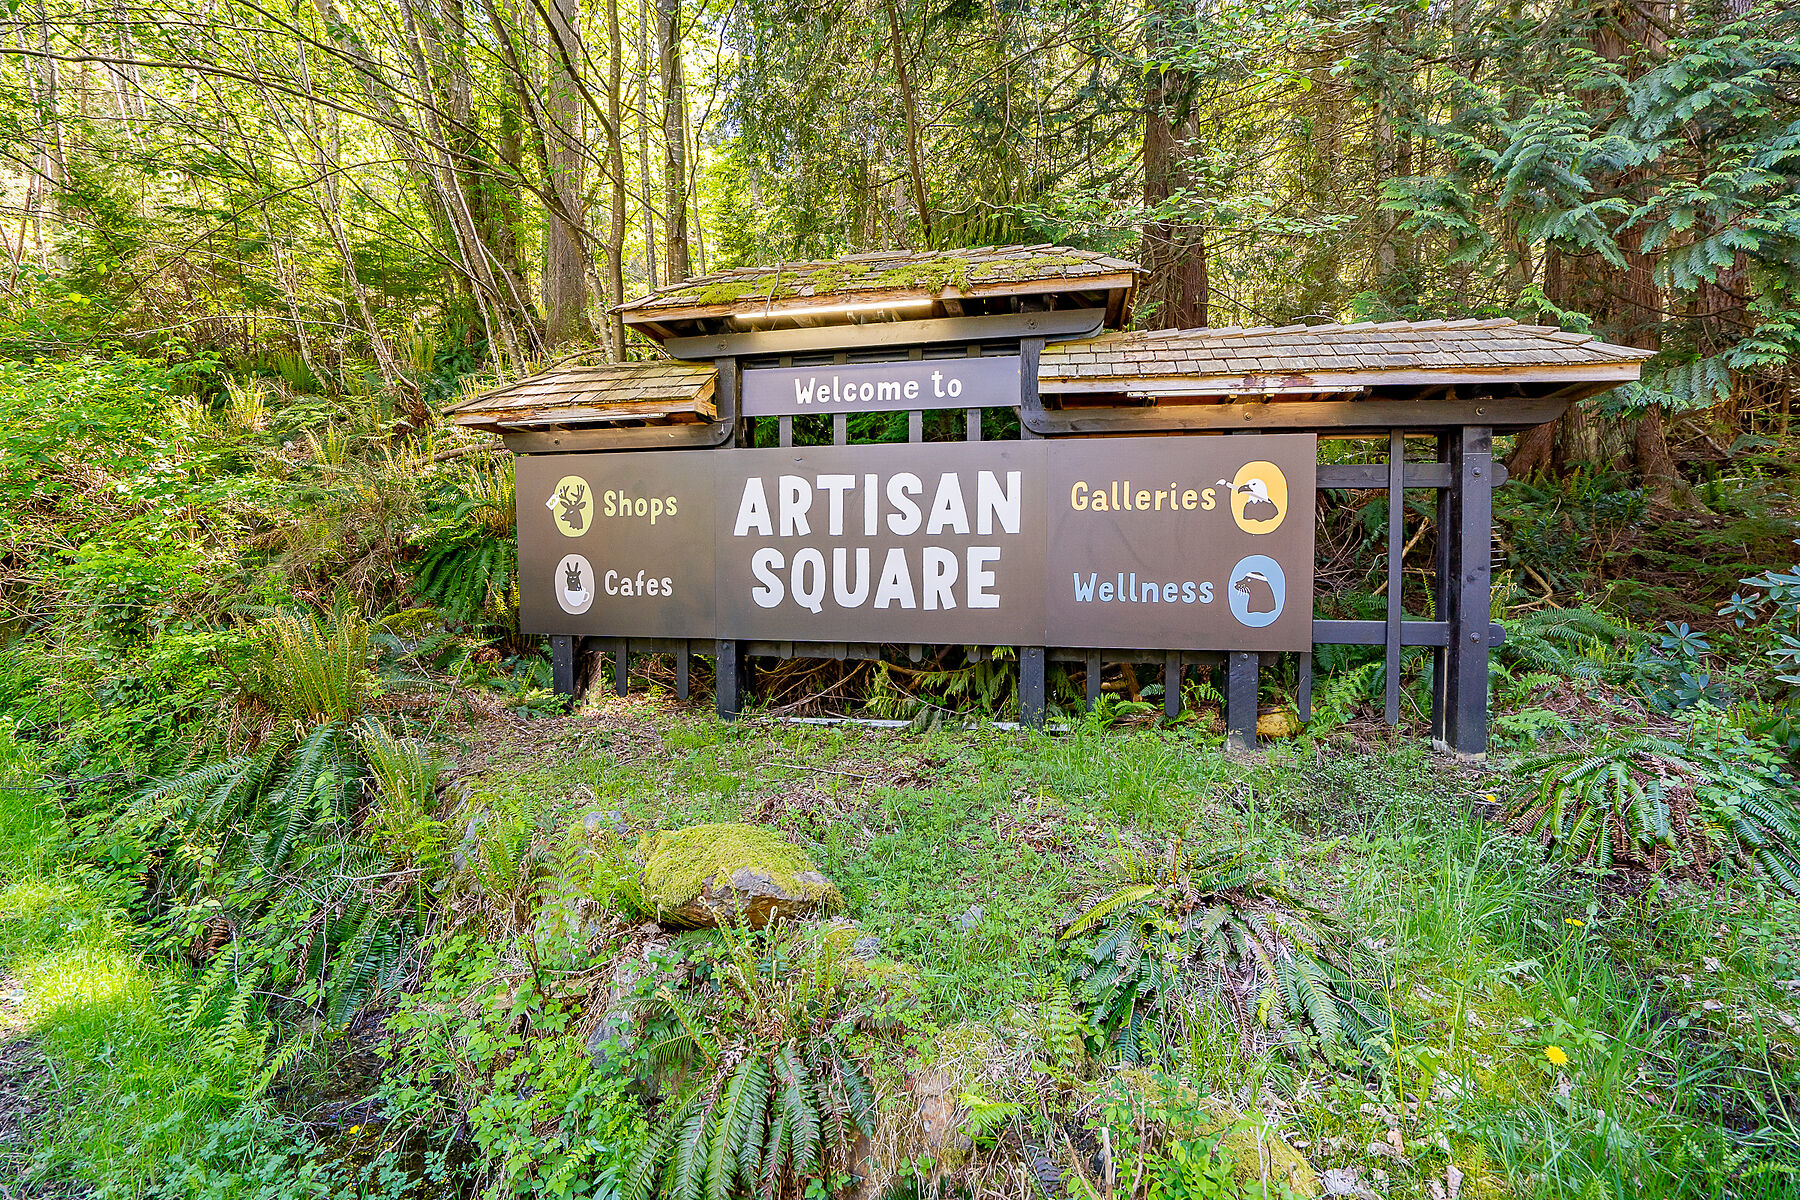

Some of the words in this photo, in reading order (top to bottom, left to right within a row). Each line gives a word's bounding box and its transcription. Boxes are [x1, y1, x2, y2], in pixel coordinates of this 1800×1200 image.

[794, 375, 919, 405] Welcome
[930, 370, 963, 398] to
[603, 489, 678, 525] Shops
[733, 470, 1022, 537] ARTISAN
[1070, 480, 1217, 512] Galleries
[604, 569, 673, 597] Cafes
[751, 546, 1002, 614] SQUARE
[1073, 572, 1214, 604] Wellness
